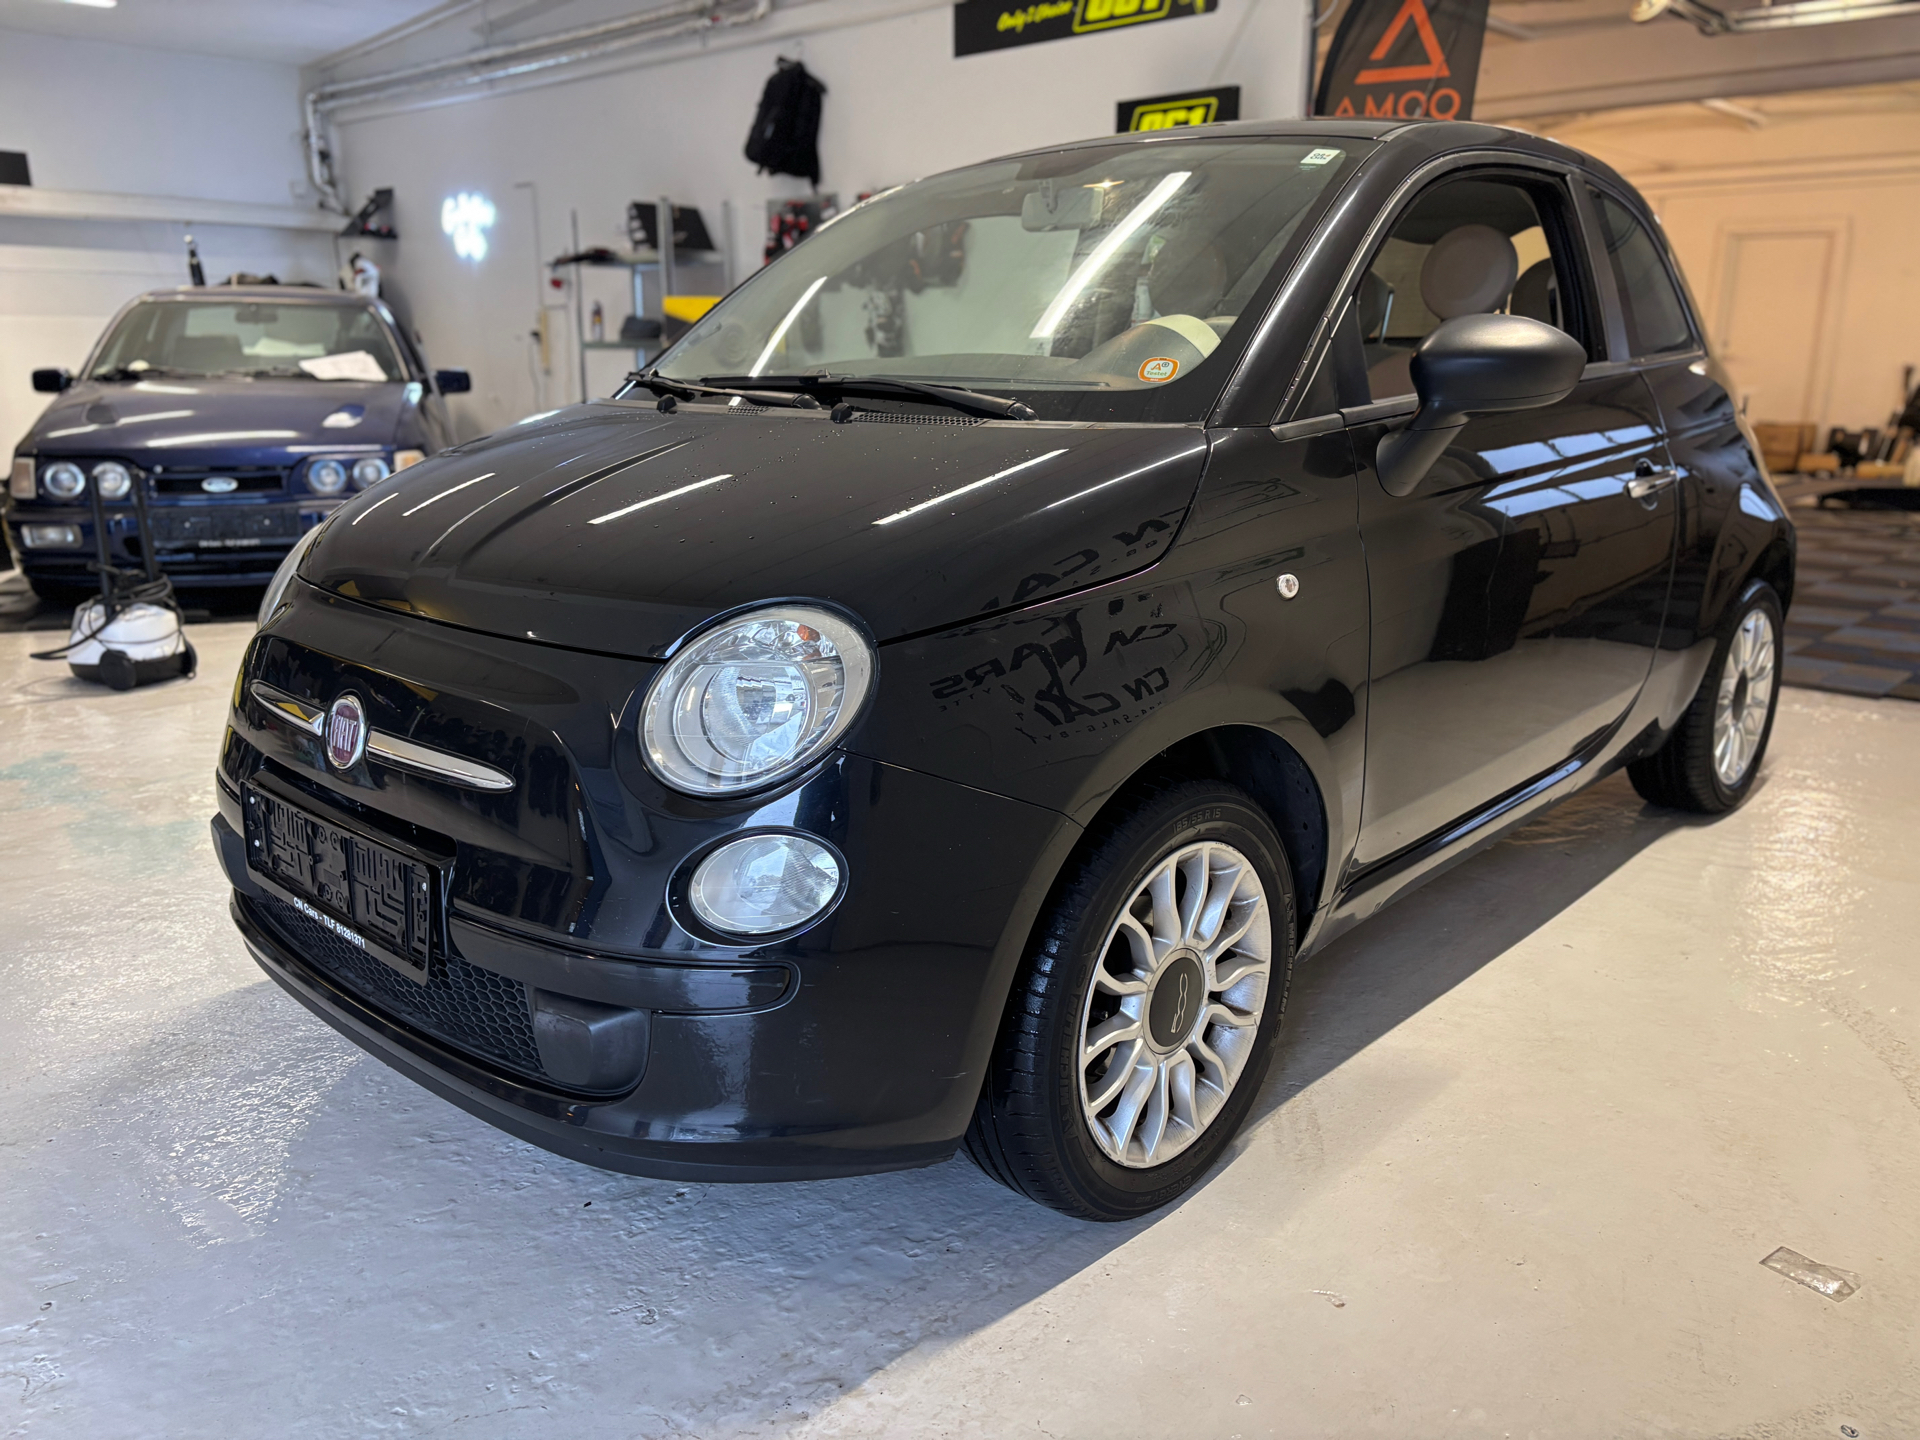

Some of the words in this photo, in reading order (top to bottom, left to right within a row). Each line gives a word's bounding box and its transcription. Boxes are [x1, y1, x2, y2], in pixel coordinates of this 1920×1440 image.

[333, 714, 357, 752] FIAT
[1172, 811, 1203, 834] 185/55
[294, 897, 303, 911] CN
[304, 903, 318, 920] Cars
[323, 914, 335, 929] TLF
[1059, 994, 1080, 1106] MICHELIN
